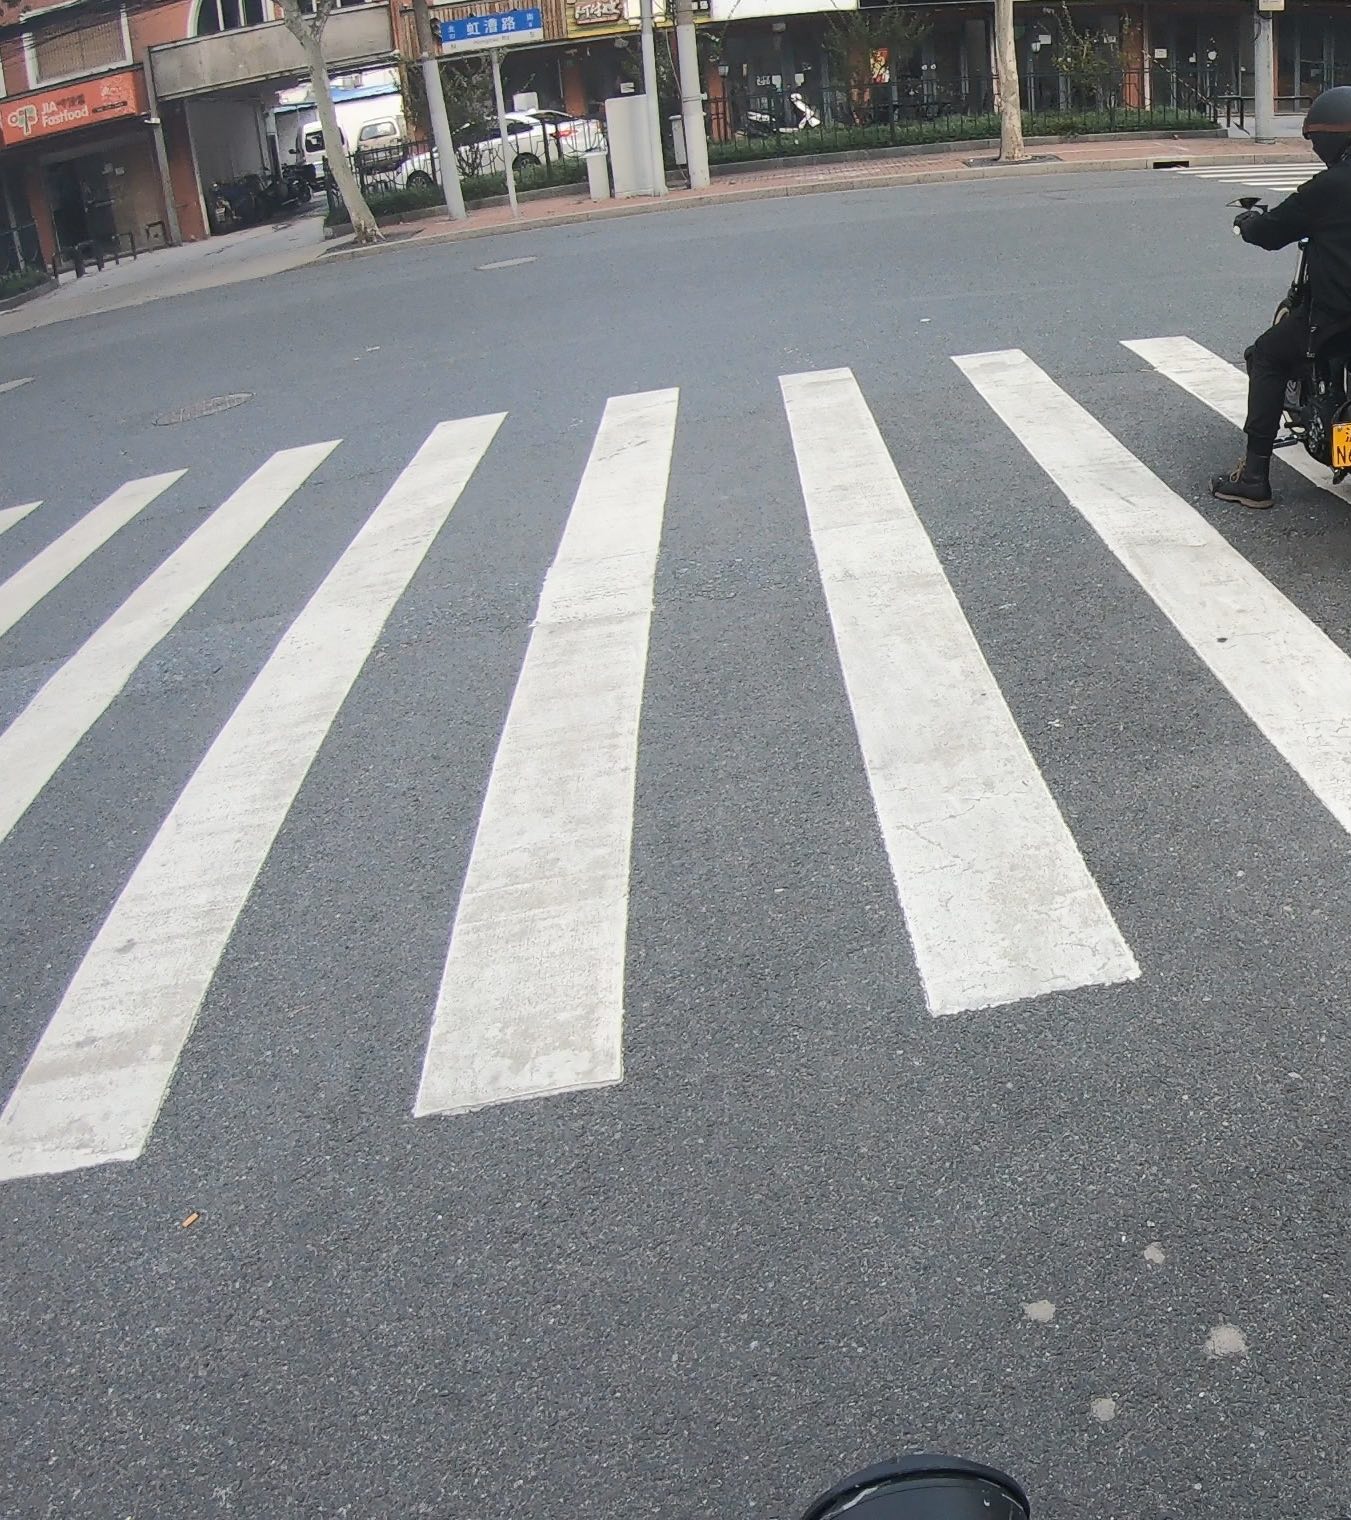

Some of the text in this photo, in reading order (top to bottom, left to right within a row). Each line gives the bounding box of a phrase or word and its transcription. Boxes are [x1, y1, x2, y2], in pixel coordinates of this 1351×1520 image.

[466, 16, 516, 36] 虹漕路
[41, 101, 58, 115] JIA
[42, 104, 89, 127] Fastfood
